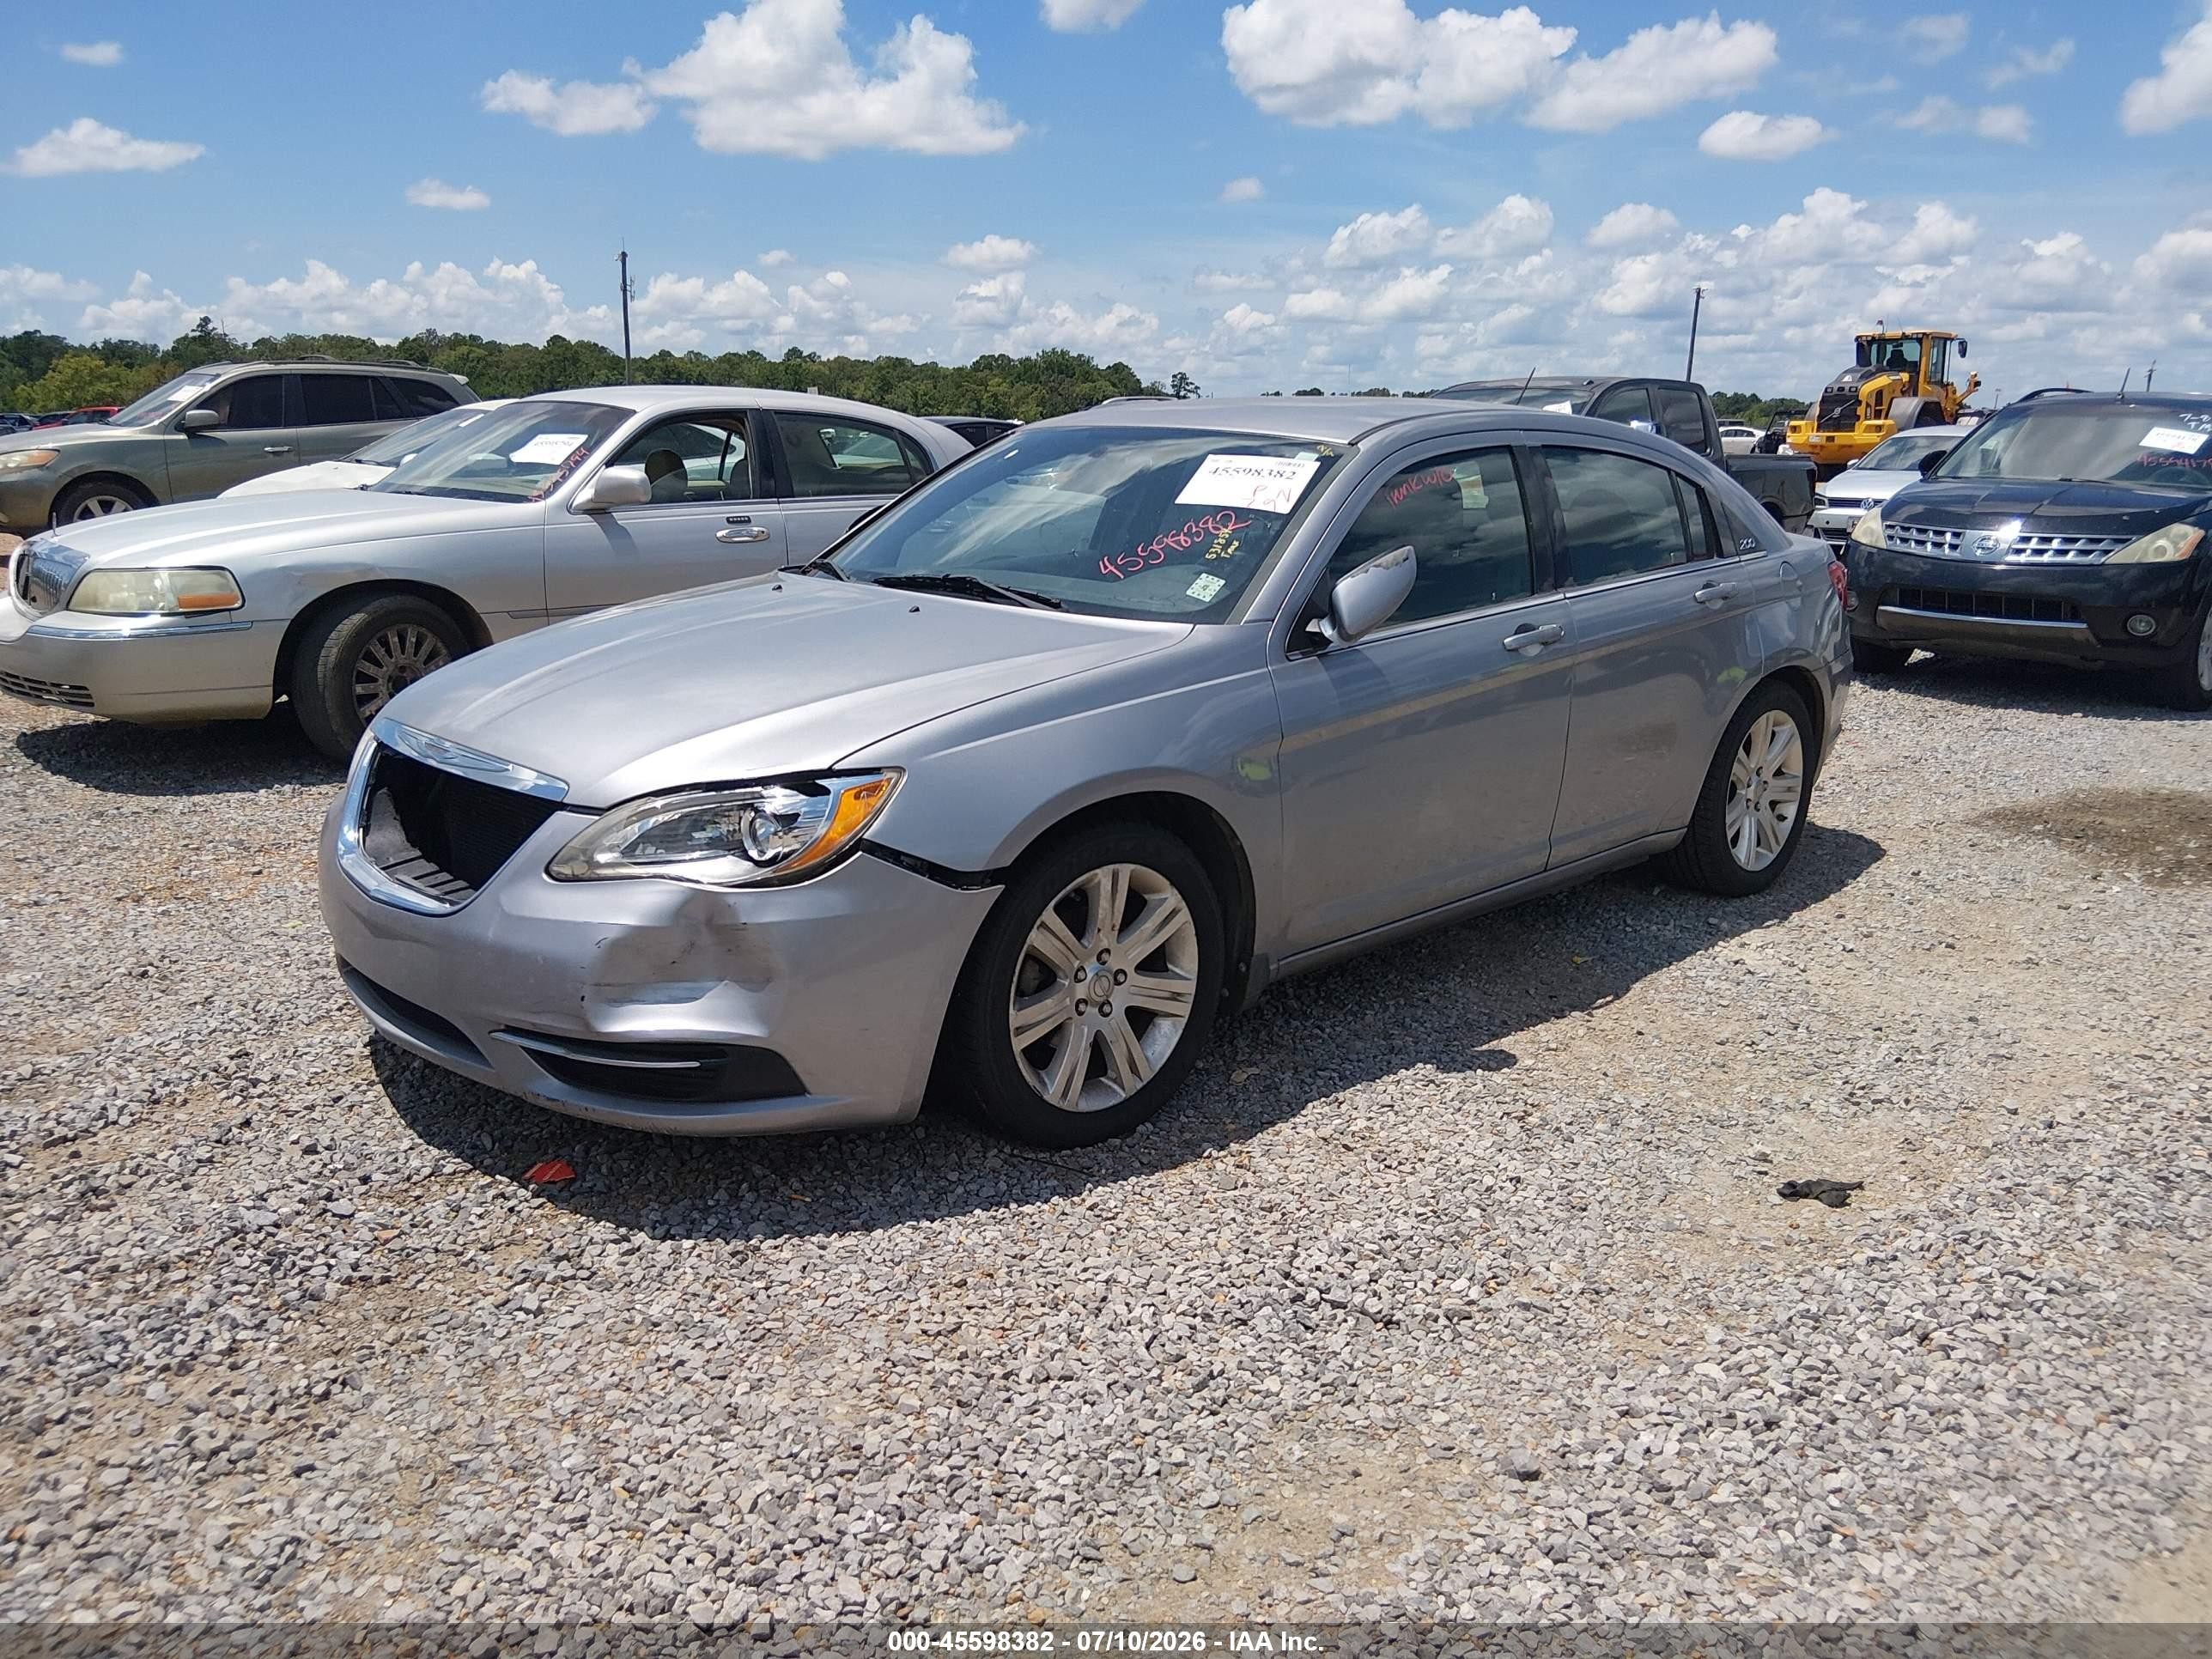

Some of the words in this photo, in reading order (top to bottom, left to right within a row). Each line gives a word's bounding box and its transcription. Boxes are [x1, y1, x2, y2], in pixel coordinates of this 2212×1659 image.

[1208, 466, 1297, 480] 45598382
[1098, 510, 1252, 580] 45598382
[1739, 538, 1756, 550] 200
